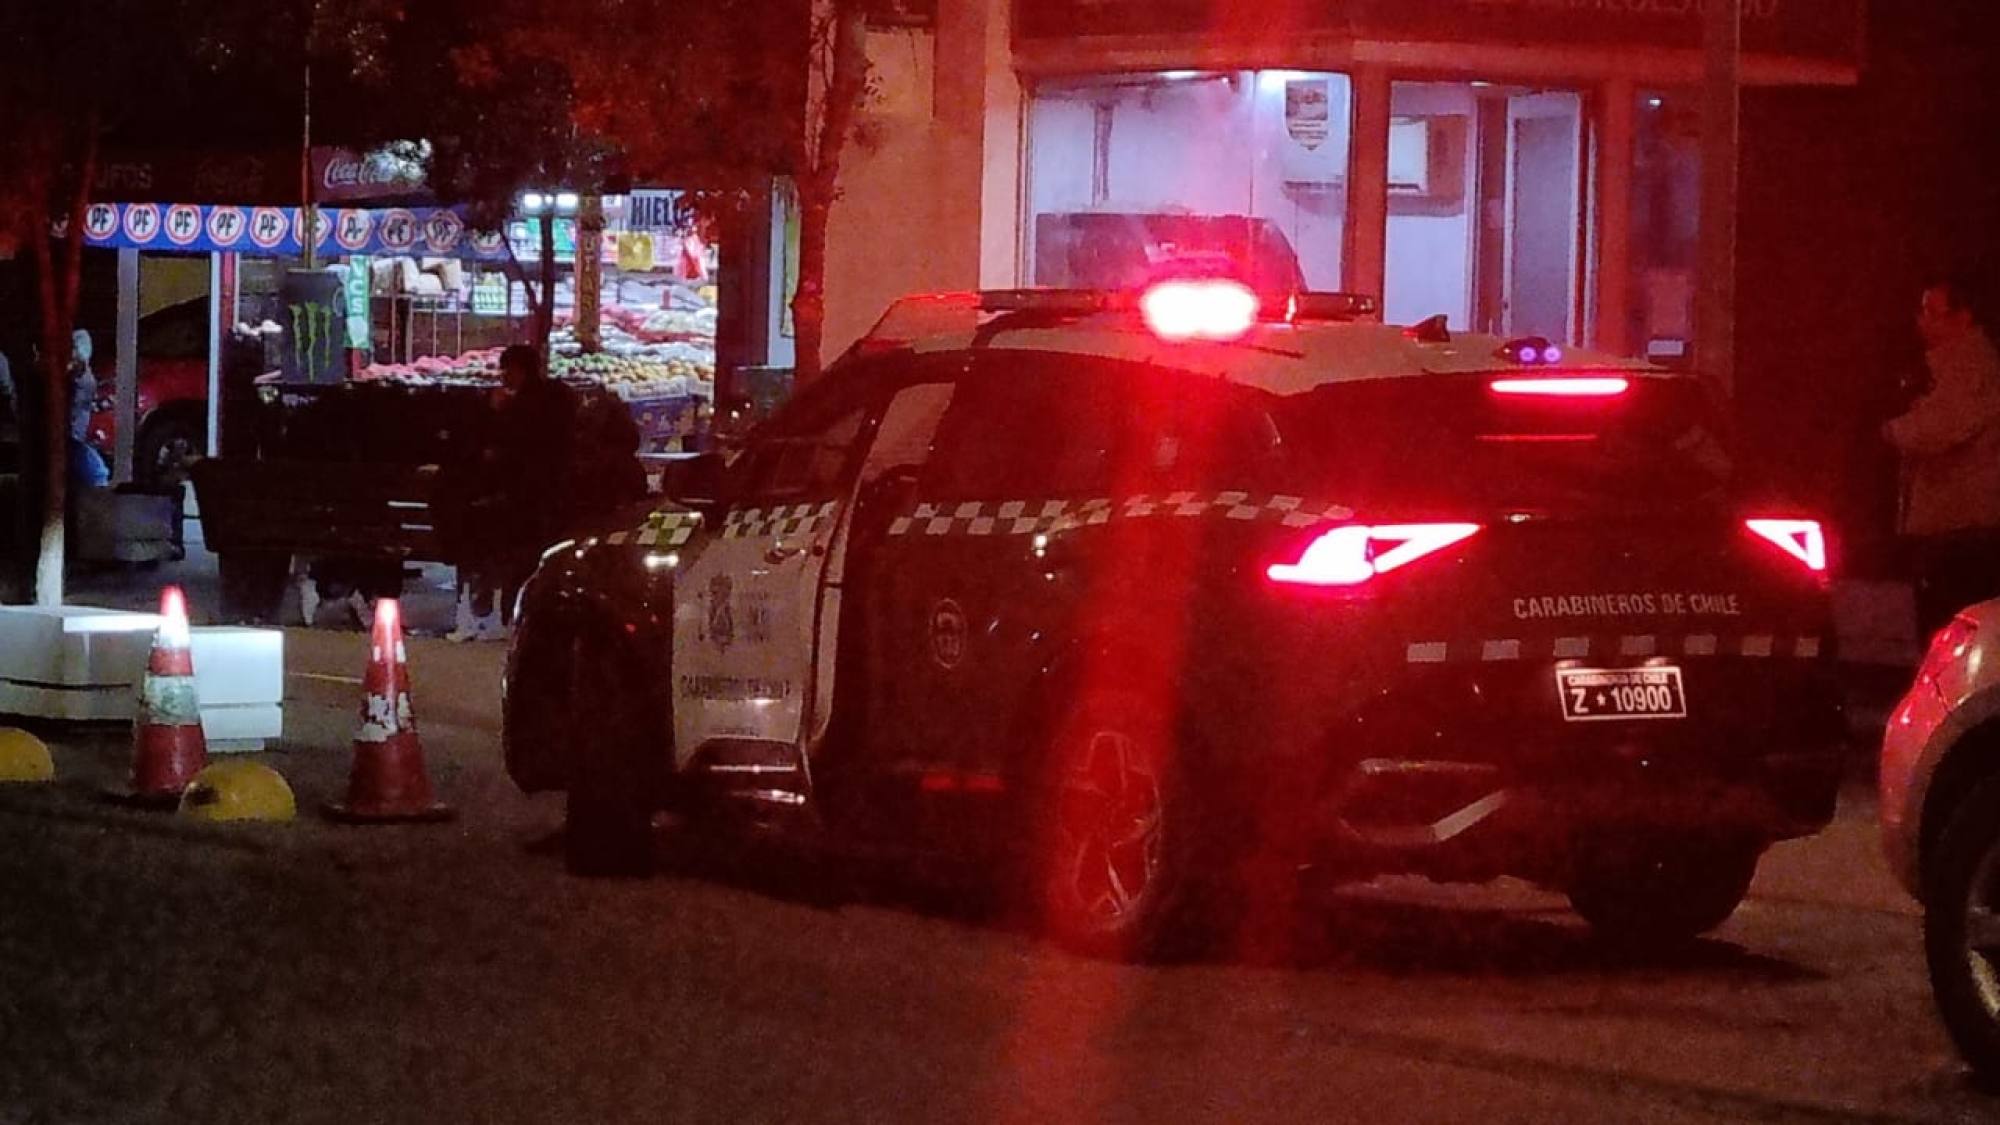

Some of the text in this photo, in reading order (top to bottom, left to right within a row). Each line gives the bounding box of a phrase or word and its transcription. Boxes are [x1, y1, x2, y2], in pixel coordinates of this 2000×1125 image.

[132, 208, 151, 232] PF
[174, 210, 193, 233] PF
[216, 212, 236, 236] PF
[260, 213, 278, 237] PF
[631, 196, 692, 227] HIEL
[1513, 592, 1741, 619] CARABINEROS DE CHILE
[1569, 685, 1673, 714] Z 10900
